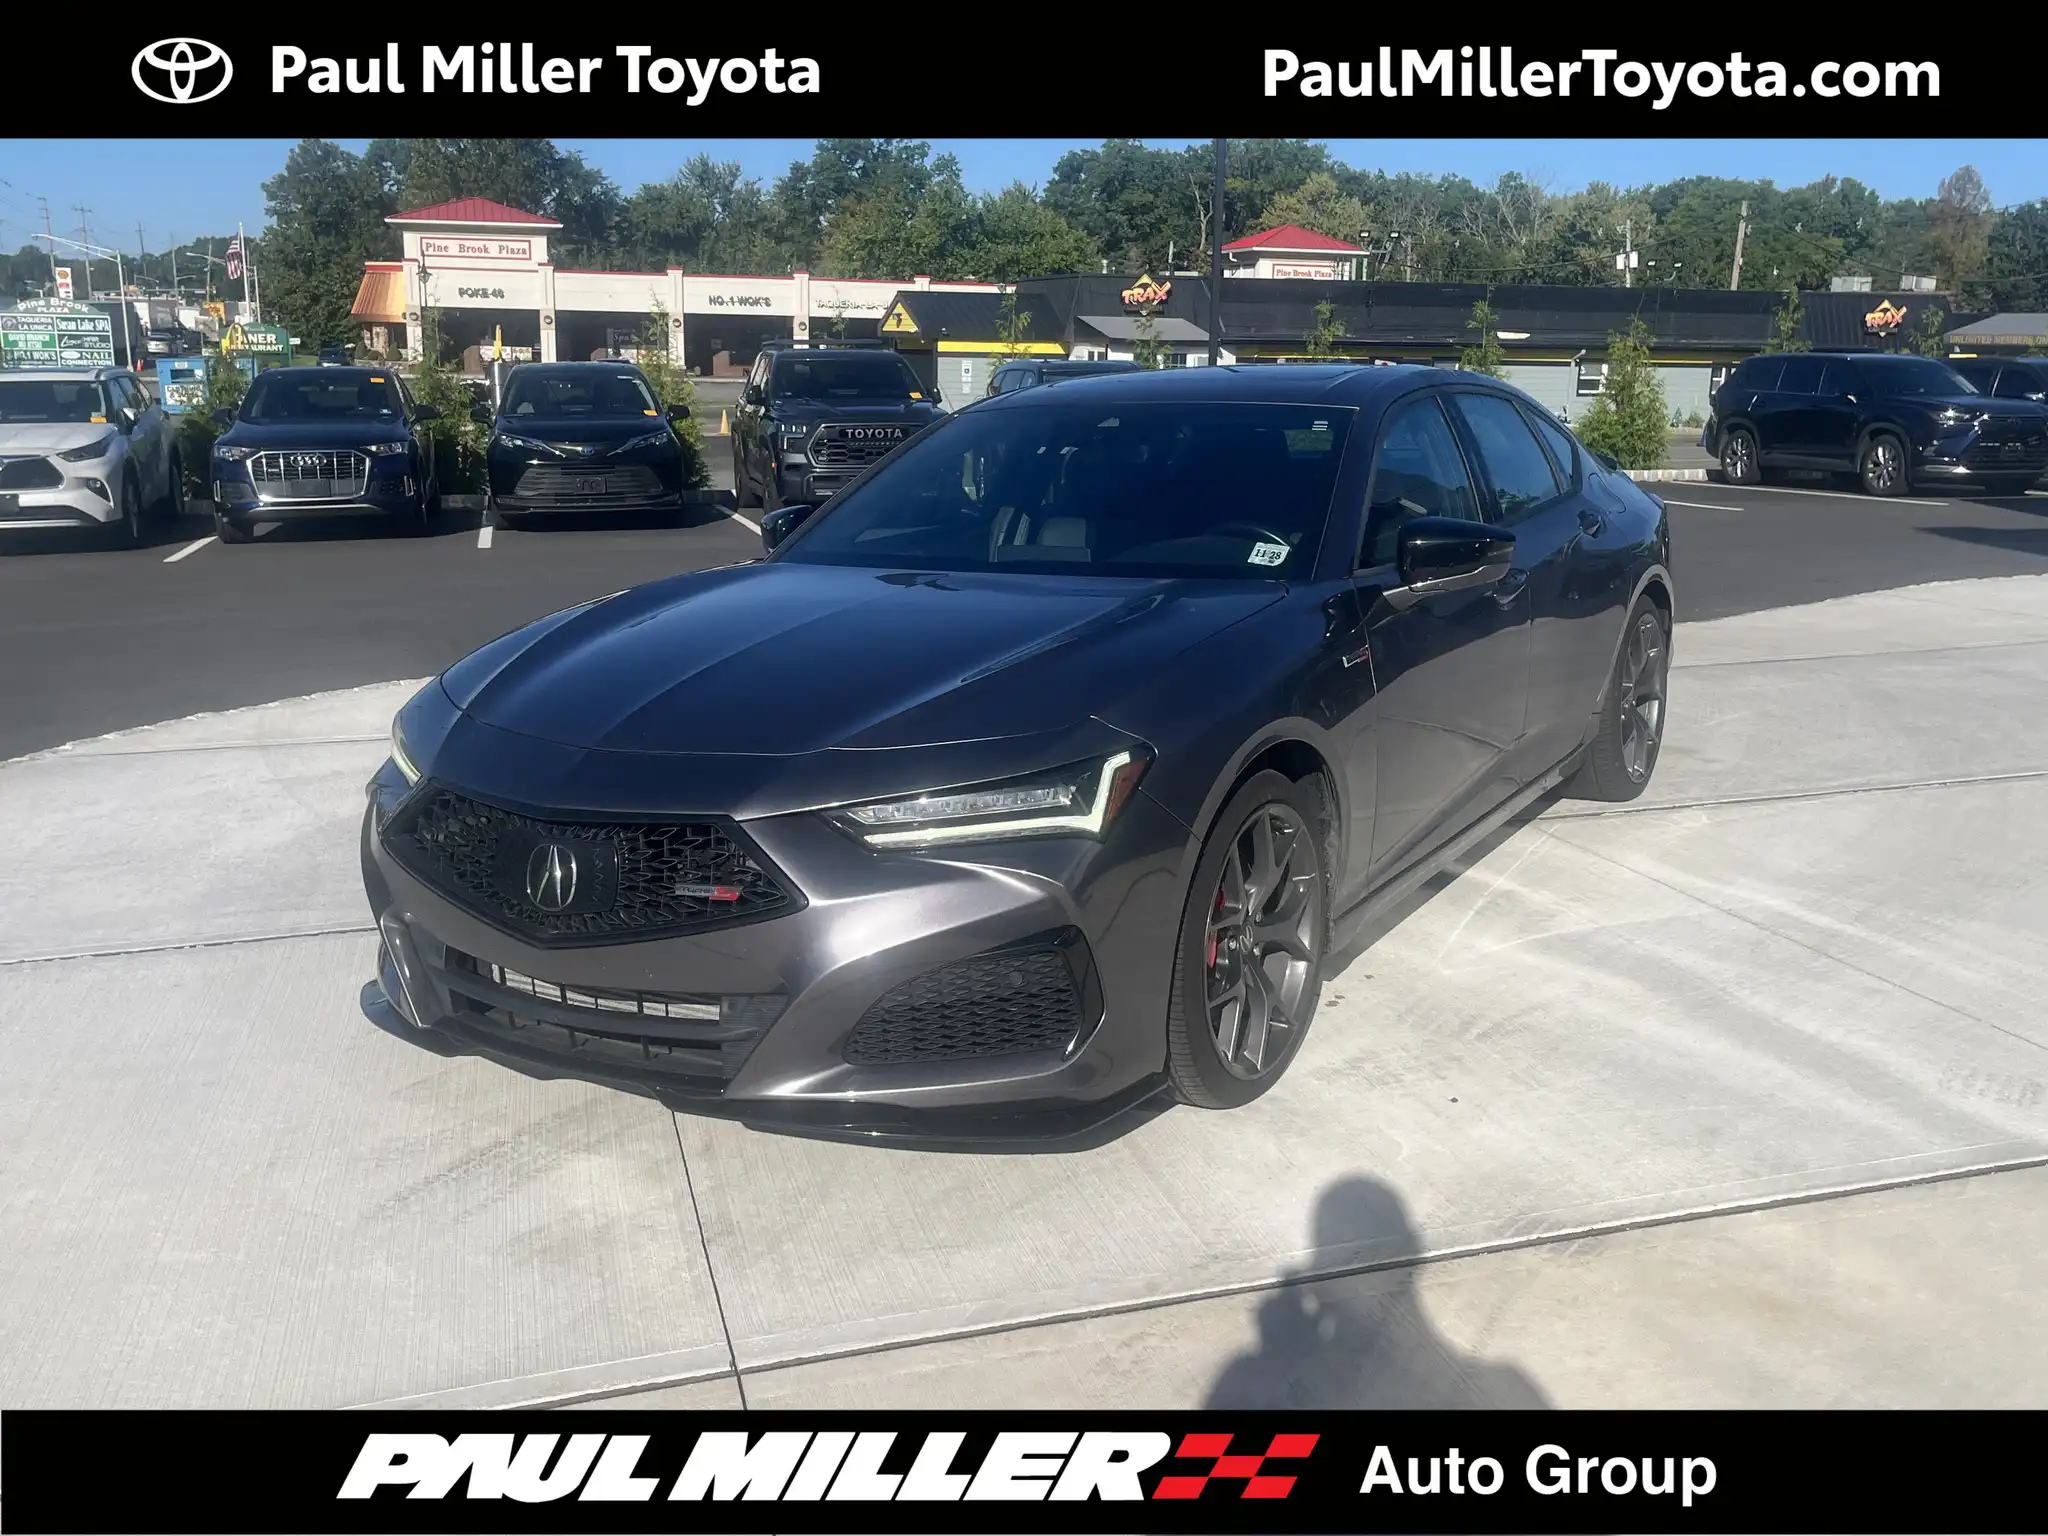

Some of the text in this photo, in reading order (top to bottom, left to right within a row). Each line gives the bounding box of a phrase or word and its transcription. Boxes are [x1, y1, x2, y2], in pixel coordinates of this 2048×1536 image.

[425, 242, 528, 255] Pine Brook Plaza
[1121, 281, 1172, 304] TRAX
[17, 297, 89, 313] Pine Brook
[737, 296, 772, 307] WOK'S
[1865, 306, 1908, 328] TRAX
[95, 319, 110, 331] SPA
[33, 351, 57, 360] WOK'S
[82, 352, 111, 360] NAIL
[845, 428, 904, 439] TOYOTA
